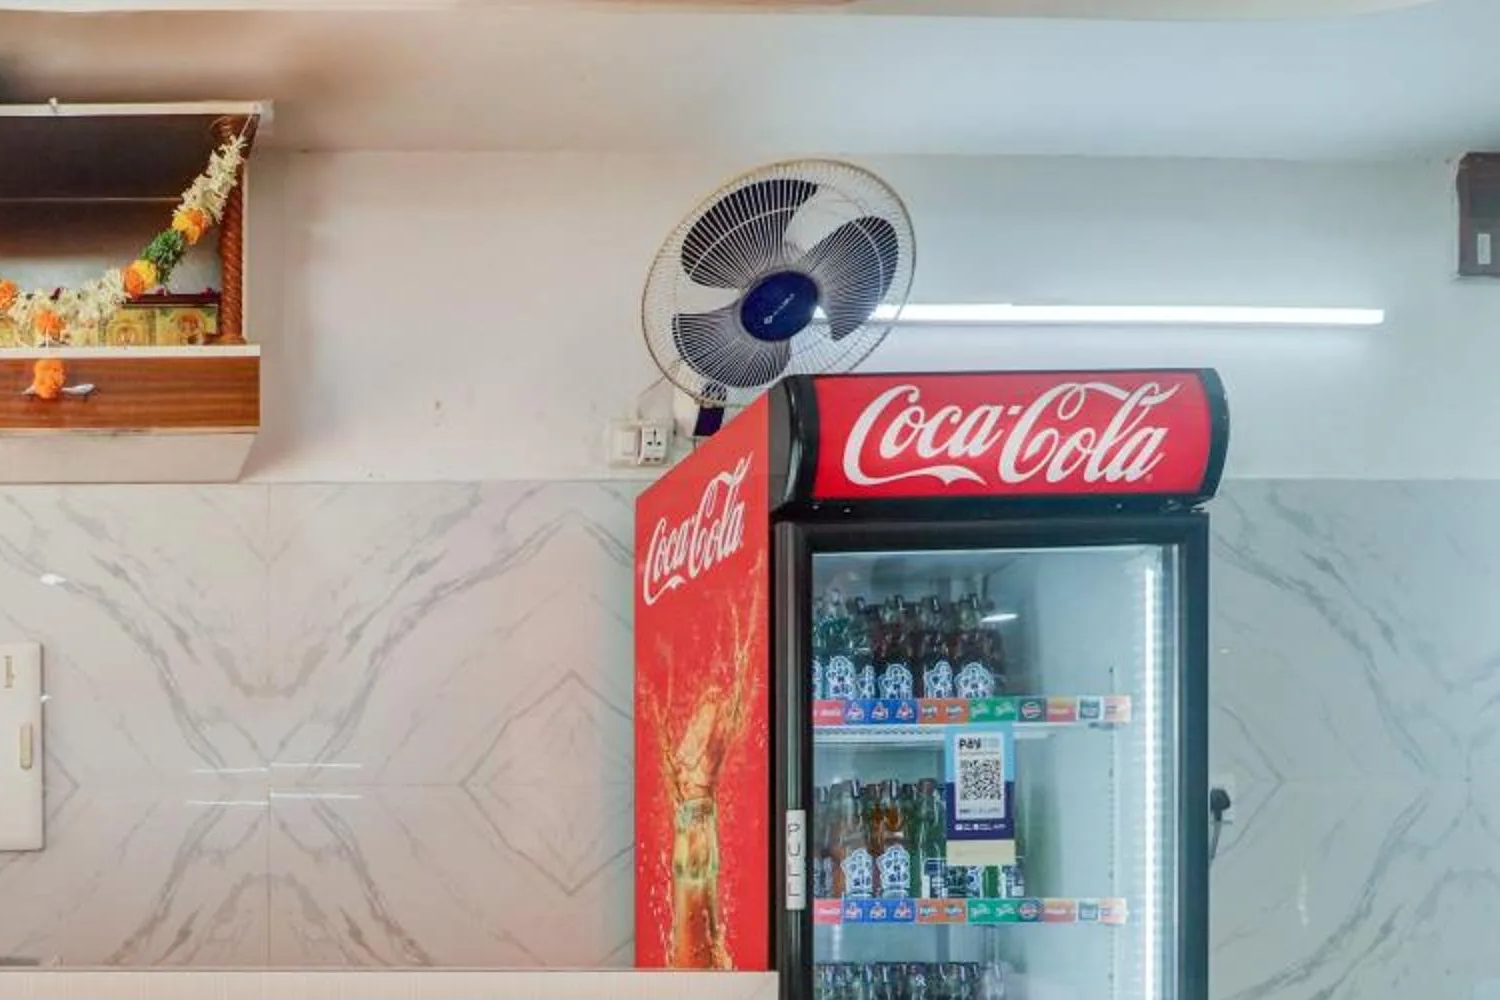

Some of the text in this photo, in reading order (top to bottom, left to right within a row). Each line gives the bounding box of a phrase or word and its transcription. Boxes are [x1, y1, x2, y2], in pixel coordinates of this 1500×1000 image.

[843, 382, 1181, 486] Coca-Cola
[643, 452, 753, 606] Coca-Cola
[787, 823, 801, 897] PULL
